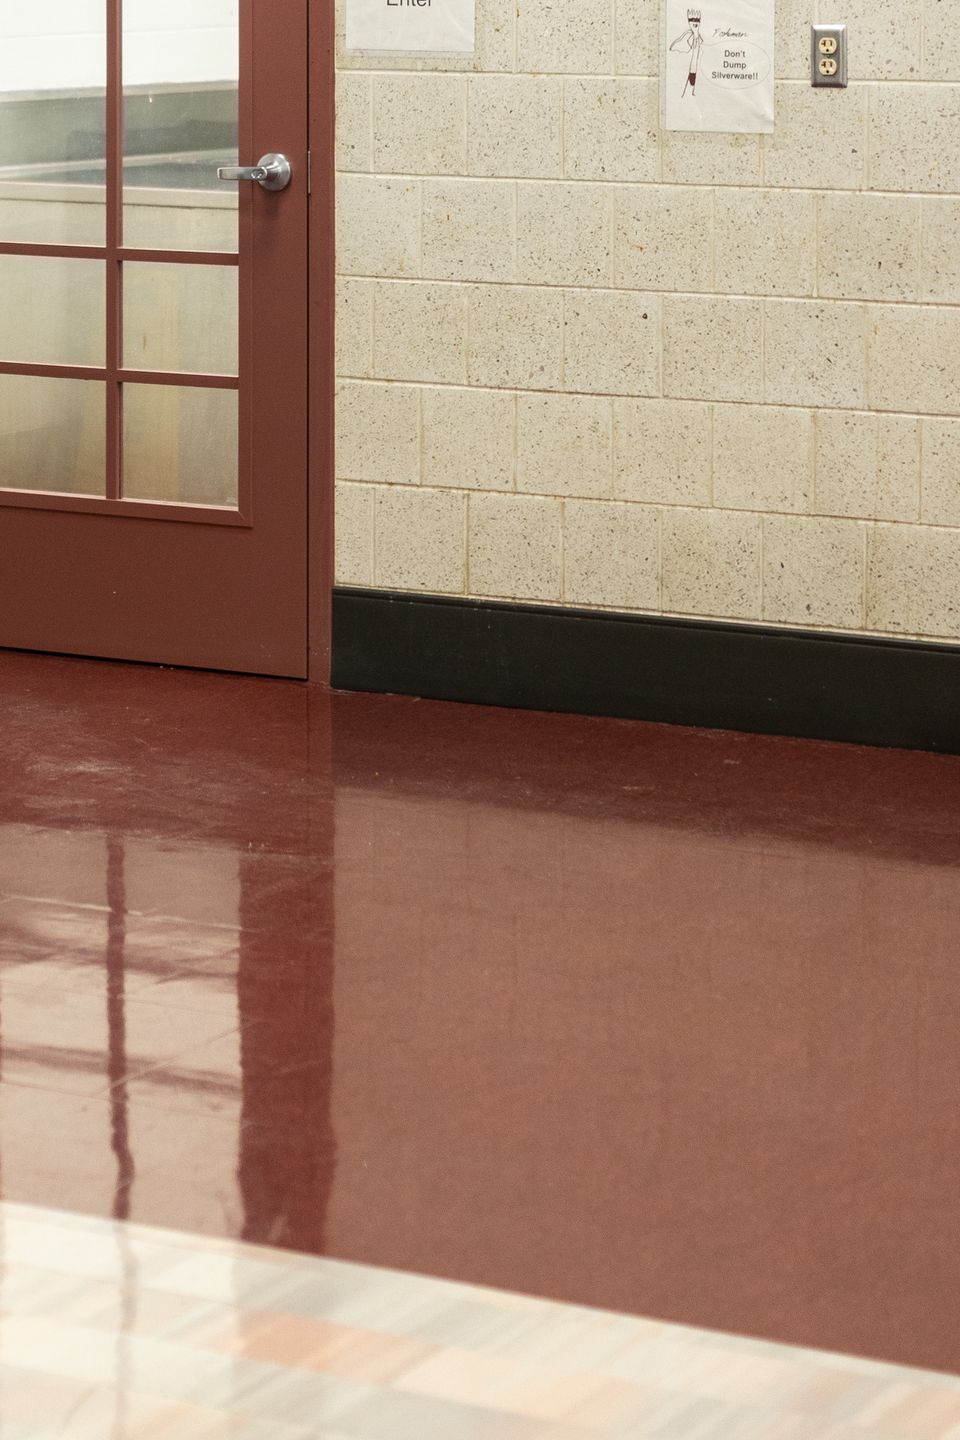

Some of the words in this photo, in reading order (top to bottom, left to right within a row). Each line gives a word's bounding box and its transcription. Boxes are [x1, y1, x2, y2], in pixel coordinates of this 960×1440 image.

[724, 49, 746, 58] Don't
[723, 60, 747, 70] Dump
[711, 71, 759, 80] Silverware!!
